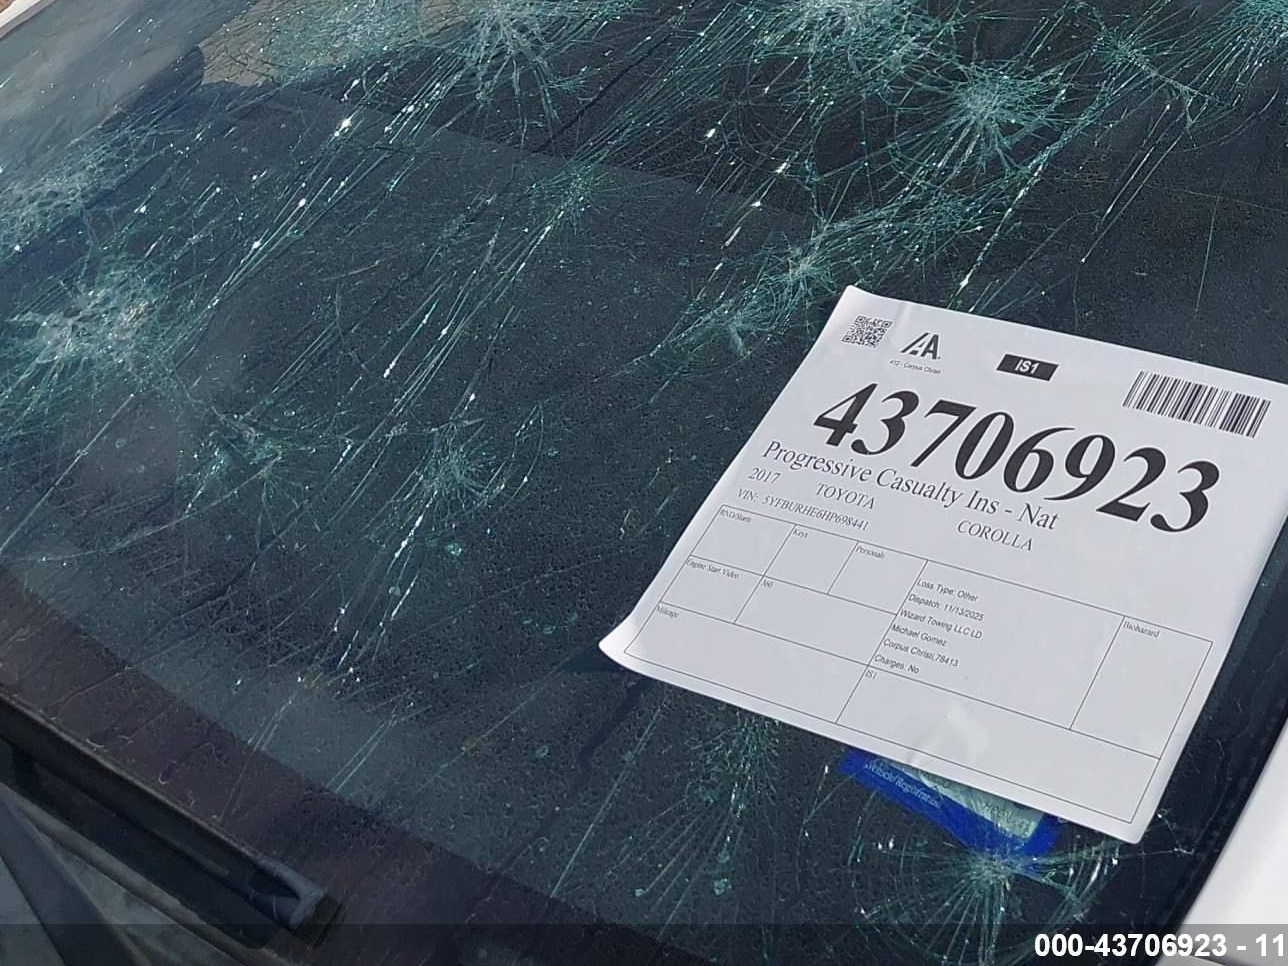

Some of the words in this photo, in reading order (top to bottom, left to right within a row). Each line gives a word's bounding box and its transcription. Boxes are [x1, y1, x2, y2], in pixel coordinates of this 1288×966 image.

[1015, 359, 1040, 375] IS1
[813, 383, 1220, 533] 43706923
[738, 488, 759, 503] VIN:
[762, 441, 872, 481] Progressive
[876, 468, 964, 509] Casualty
[966, 489, 998, 515] Ins
[1017, 503, 1060, 530] Nat
[747, 467, 782, 485] 2017
[815, 483, 876, 510] TOYOTA
[957, 520, 1034, 552] COROLLA
[792, 528, 808, 539] Keys
[856, 546, 886, 560] Personals
[722, 568, 740, 579] Video
[917, 579, 934, 590] Loss
[937, 583, 955, 595] Type:
[957, 590, 979, 602] Other
[657, 605, 680, 619] Mileage
[908, 593, 940, 609] Dispatch:
[944, 603, 985, 621] 11/13/2025
[900, 609, 926, 623] Wizard
[927, 616, 953, 632] Towing
[954, 624, 970, 635] LLC
[971, 629, 983, 639] LD
[1123, 620, 1160, 638] Biohazard
[891, 623, 919, 638] Michael
[920, 632, 948, 647] Gomez
[883, 638, 909, 653] Corpus
[910, 646, 959, 667] Christi,78413
[865, 669, 877, 679] IS1
[874, 654, 905, 670] Charges:
[907, 664, 920, 674] No
